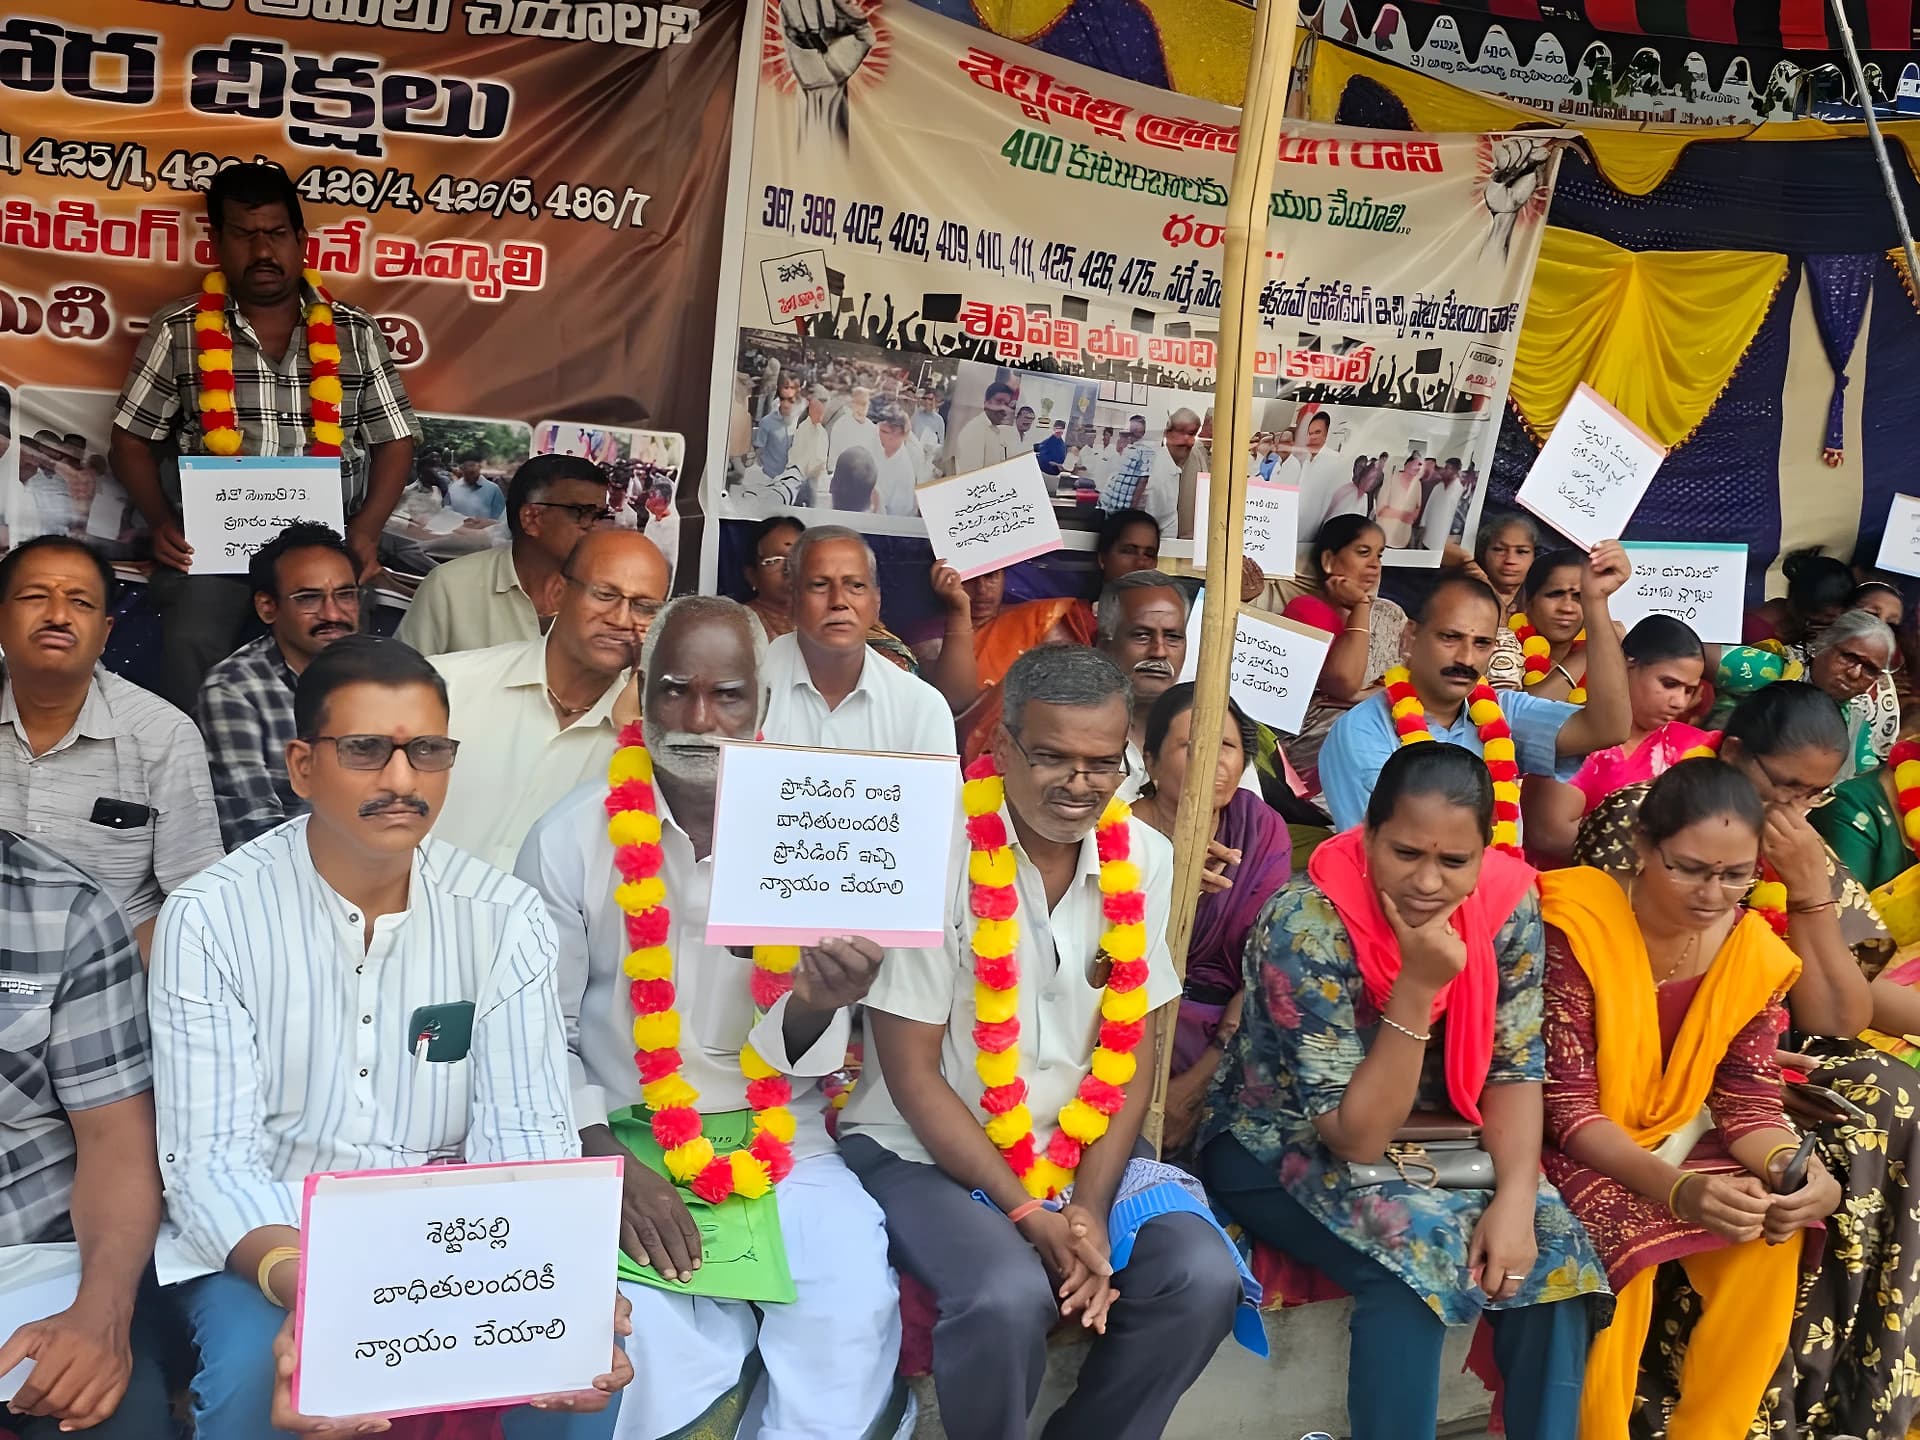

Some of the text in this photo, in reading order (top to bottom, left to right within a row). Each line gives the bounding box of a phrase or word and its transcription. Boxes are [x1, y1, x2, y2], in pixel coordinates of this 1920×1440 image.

[1001, 127, 1064, 175] 400
[296, 167, 420, 212] 426/4,
[427, 178, 538, 217] 426/5,
[545, 184, 651, 230] 486/7
[374, 237, 545, 299] ఇవ్వాలి
[843, 201, 884, 253] 402,
[889, 211, 930, 262] 403,
[936, 220, 972, 270] 409,
[975, 229, 1005, 277] 410,
[1039, 242, 1076, 289] 425,
[1078, 251, 1117, 296] 426,
[759, 873, 830, 899] న్యాయం
[426, 1217, 511, 1254] శెట్టిపల్లి
[373, 1263, 556, 1305] బాధితులందరికీ
[354, 1318, 567, 1368] న్యాయం చేయాలి
